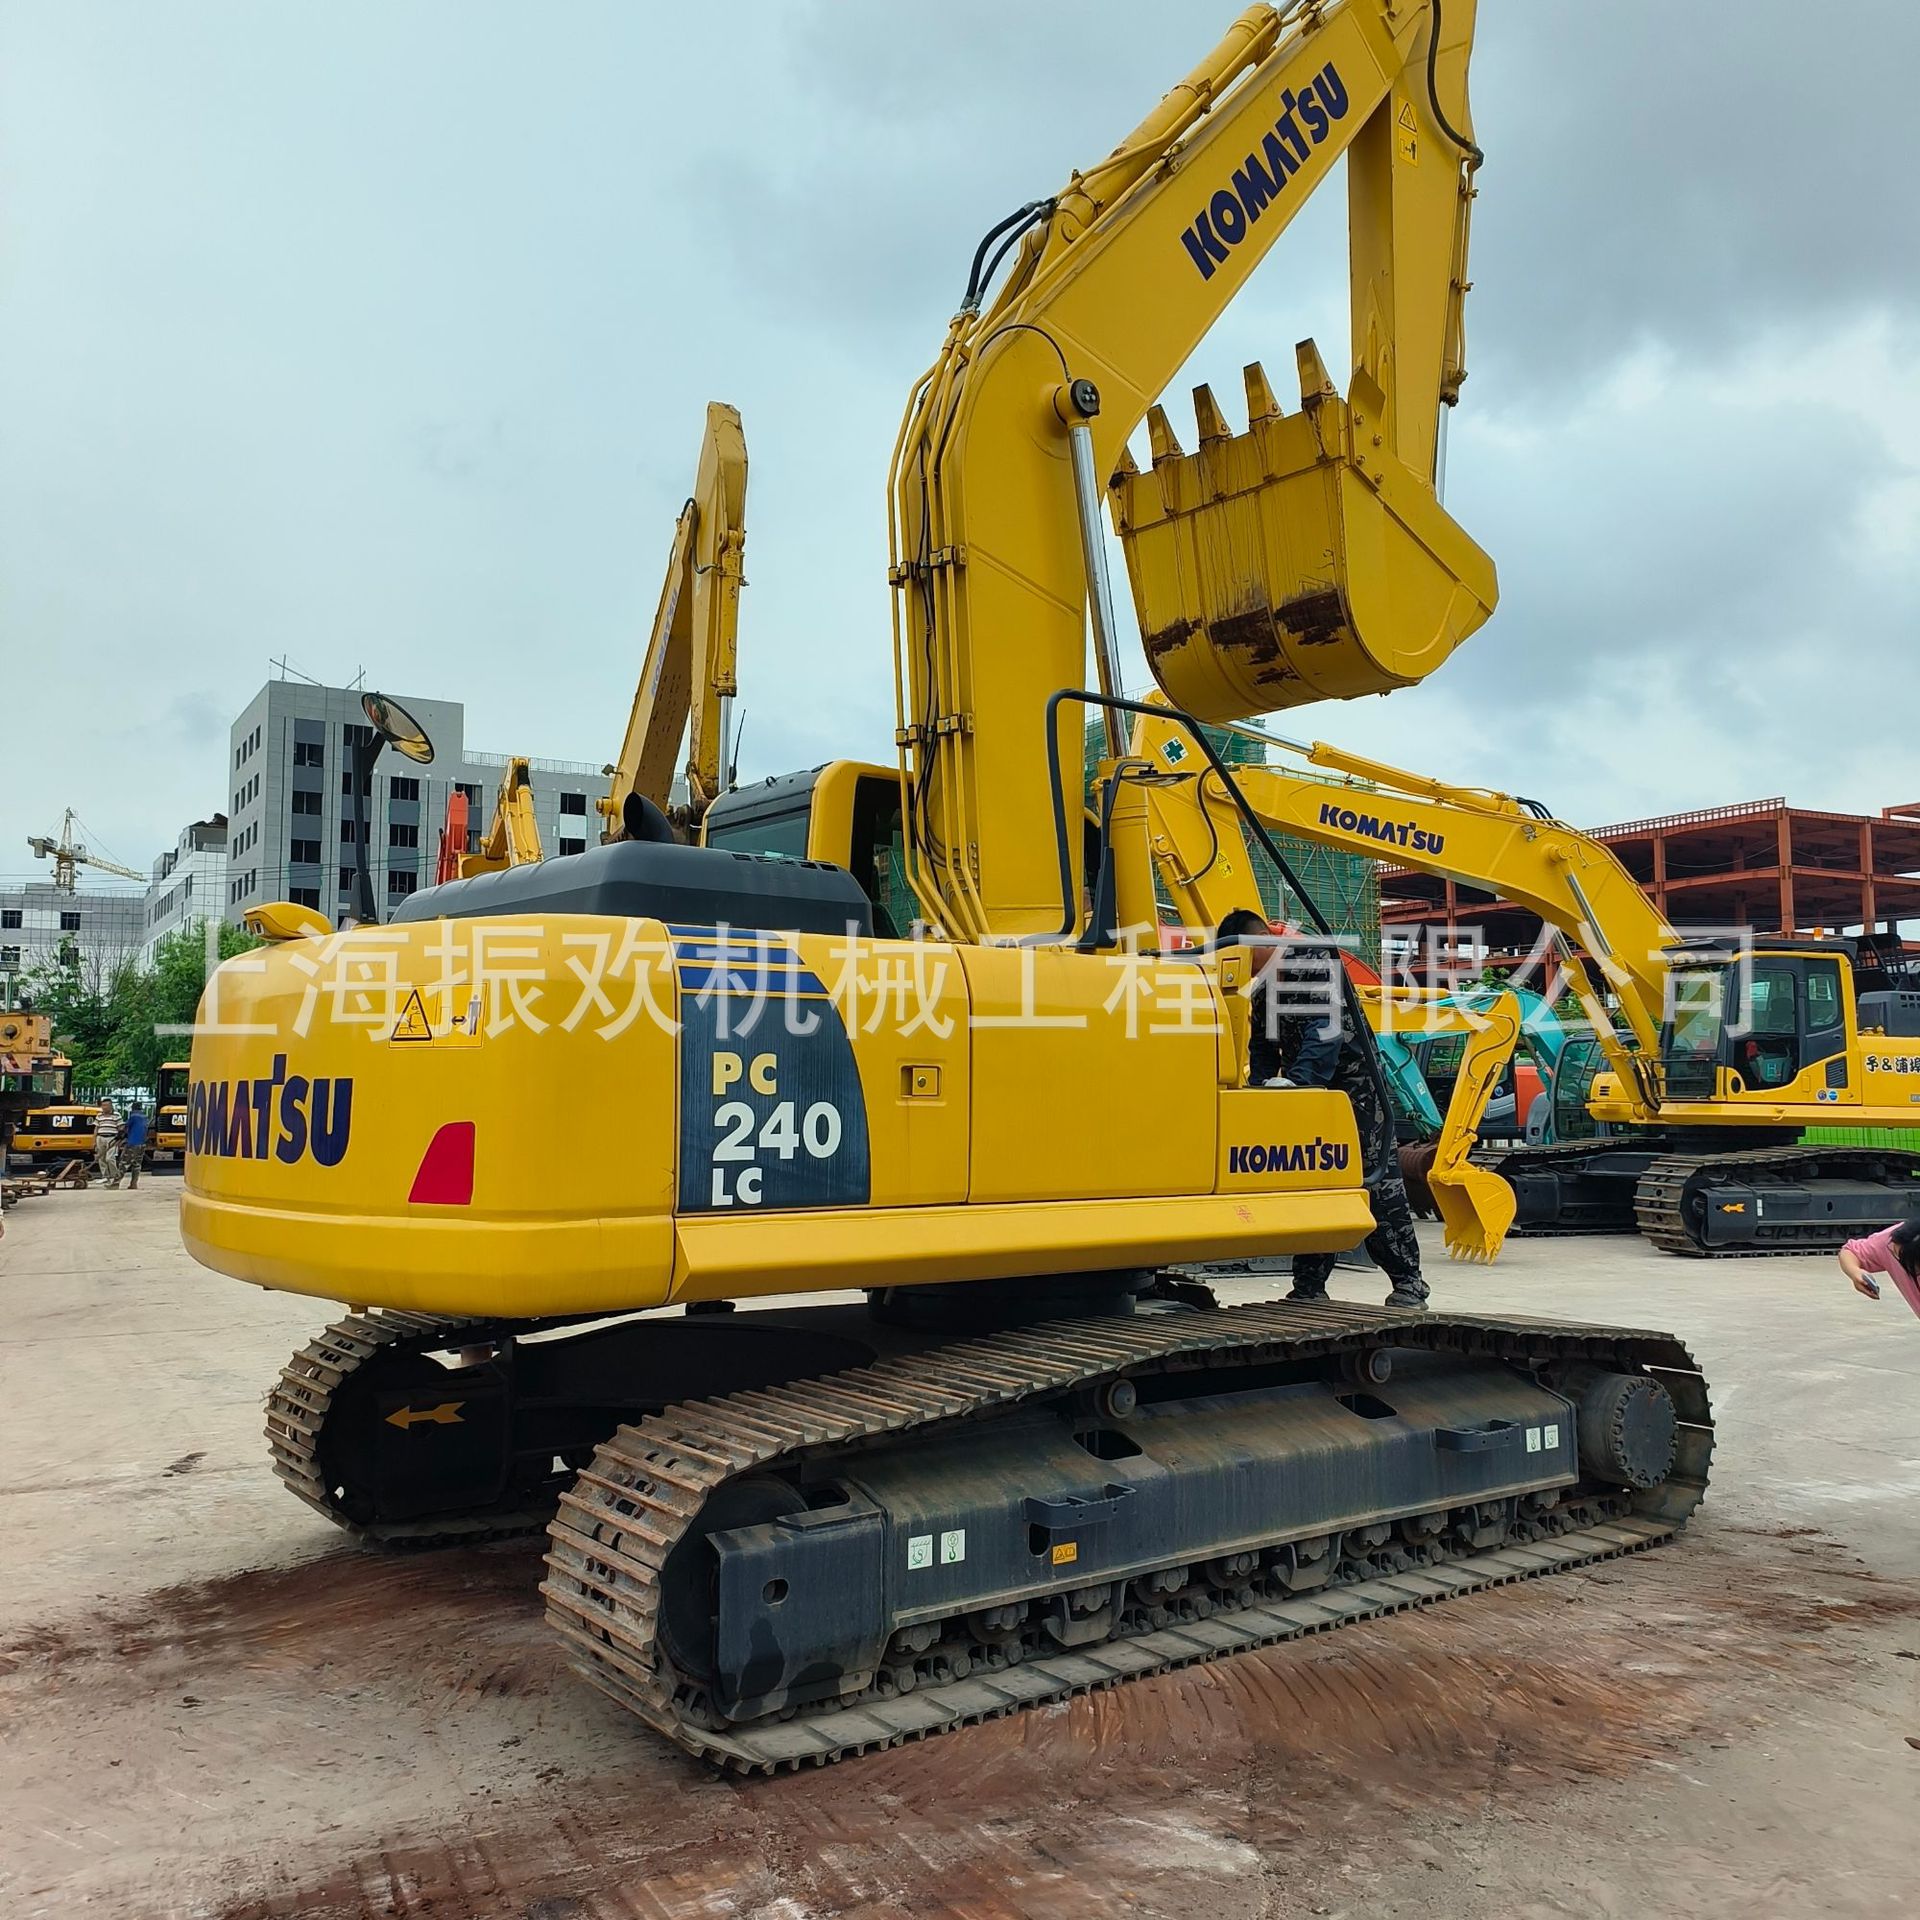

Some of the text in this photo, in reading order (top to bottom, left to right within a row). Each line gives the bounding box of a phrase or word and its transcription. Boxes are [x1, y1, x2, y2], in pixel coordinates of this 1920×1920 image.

[1180, 60, 1349, 281] KOMATSU
[1319, 803, 1444, 855] KOMATSU
[712, 1052, 777, 1095] PC
[52, 1115, 75, 1128] CAT
[712, 1101, 842, 1162] 240
[1229, 1136, 1349, 1174] KOMATSU
[711, 1167, 763, 1207] LC
